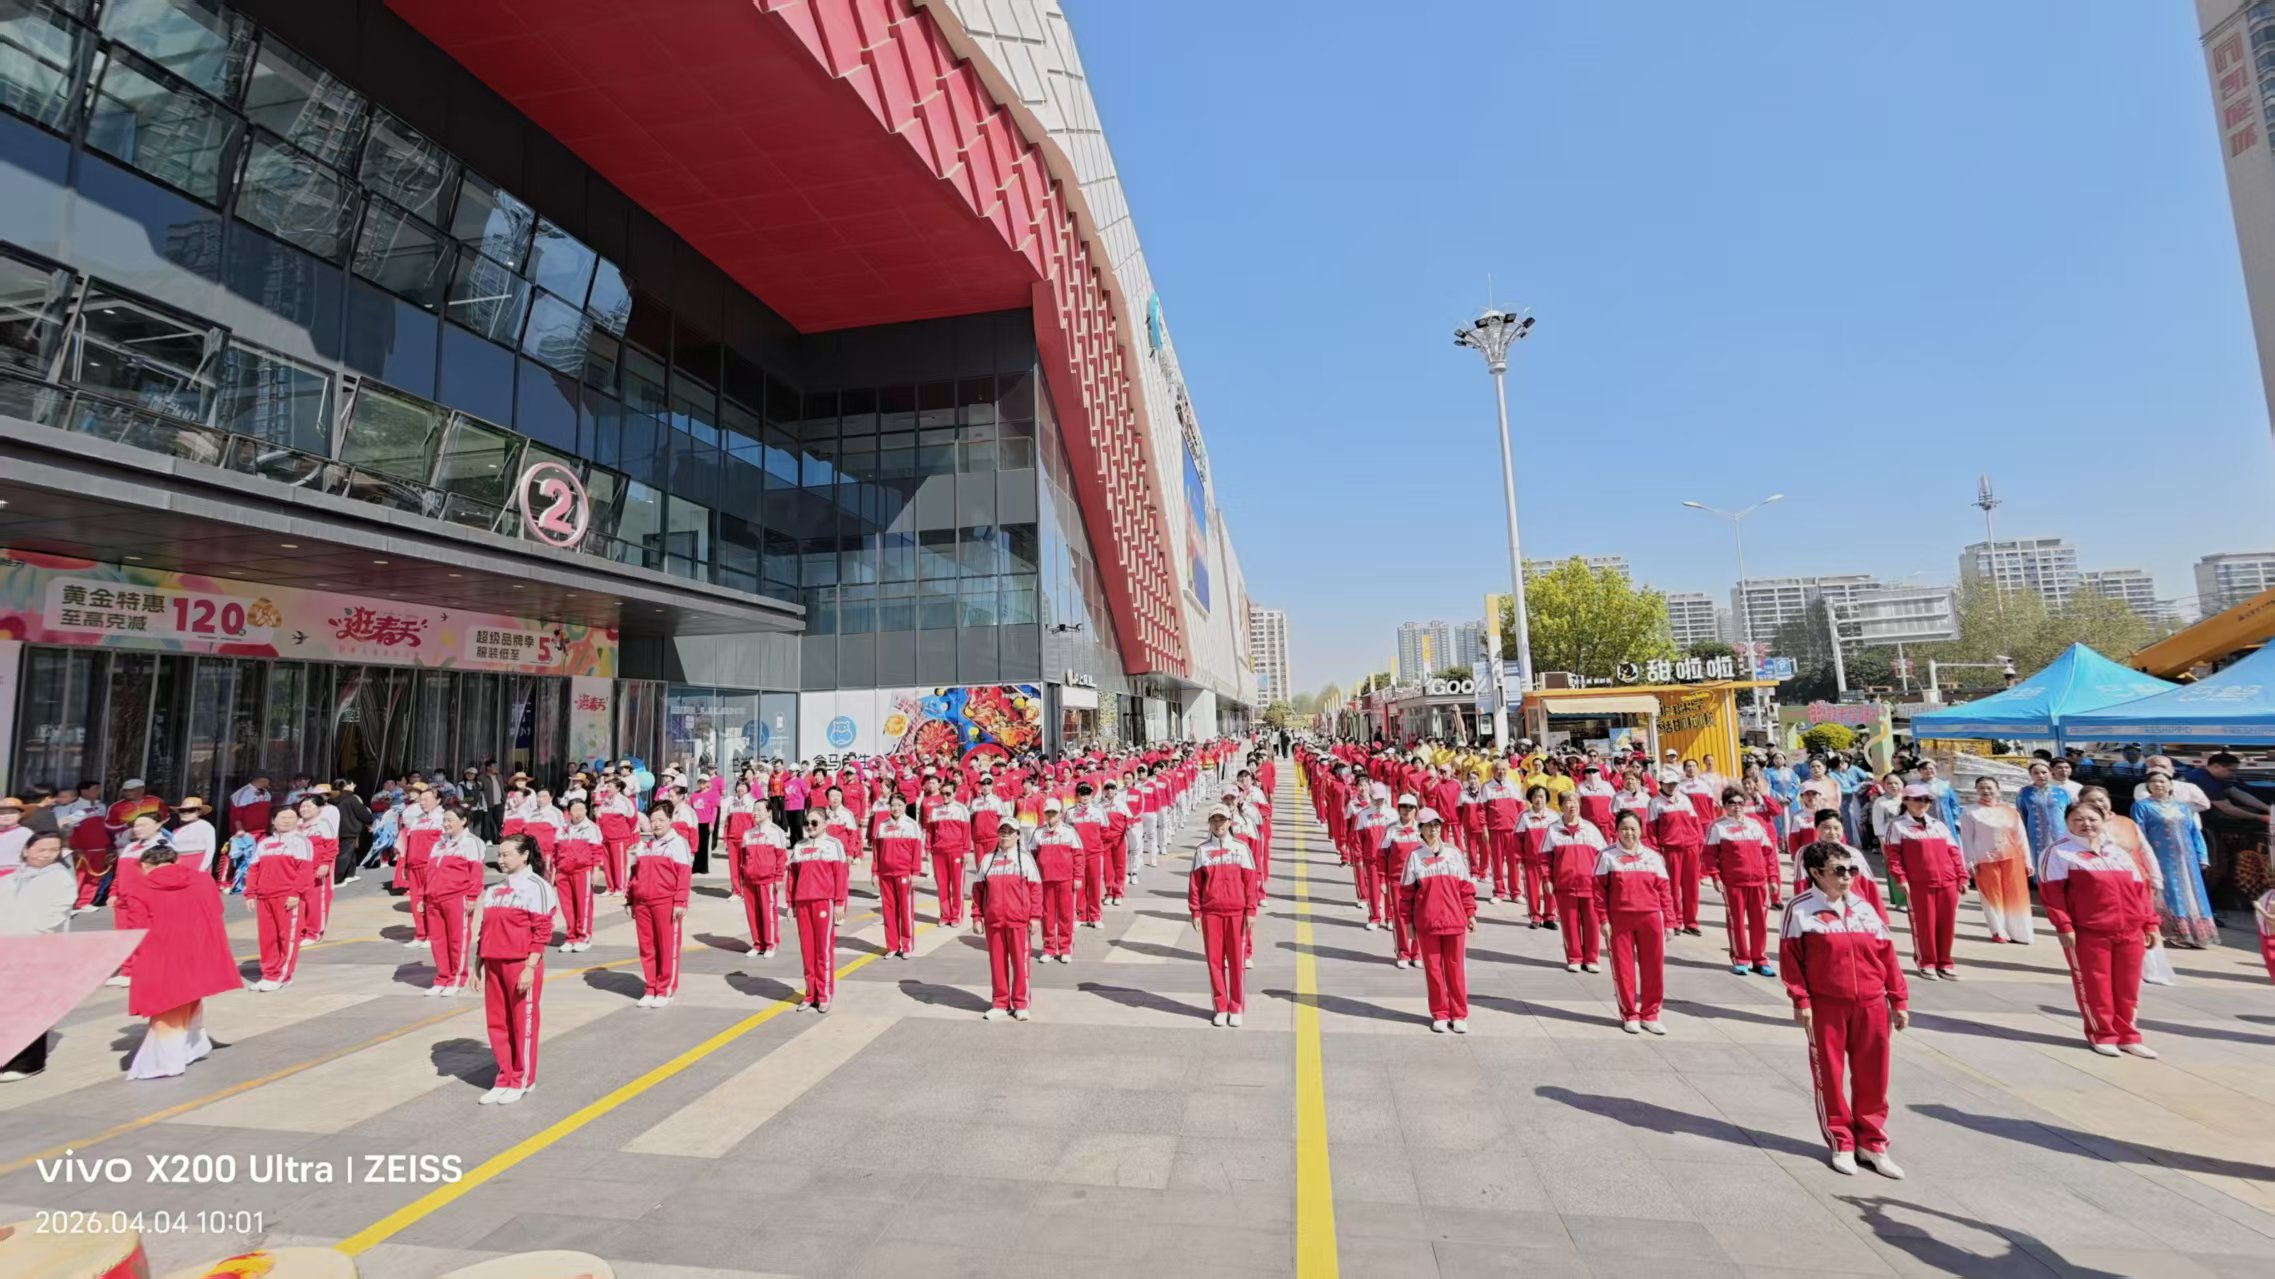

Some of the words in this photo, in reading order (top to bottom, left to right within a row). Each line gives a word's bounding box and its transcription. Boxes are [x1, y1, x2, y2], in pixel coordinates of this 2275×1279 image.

[538, 478, 575, 534] 2
[61, 584, 166, 613] 黄金特惠
[60, 608, 147, 632] 至高克减
[172, 597, 246, 636] 120
[335, 606, 422, 648] 逛春天
[475, 629, 536, 648] 超级品牌季
[475, 646, 521, 661] 服装低至
[1646, 655, 1735, 682] 甜啦啦
